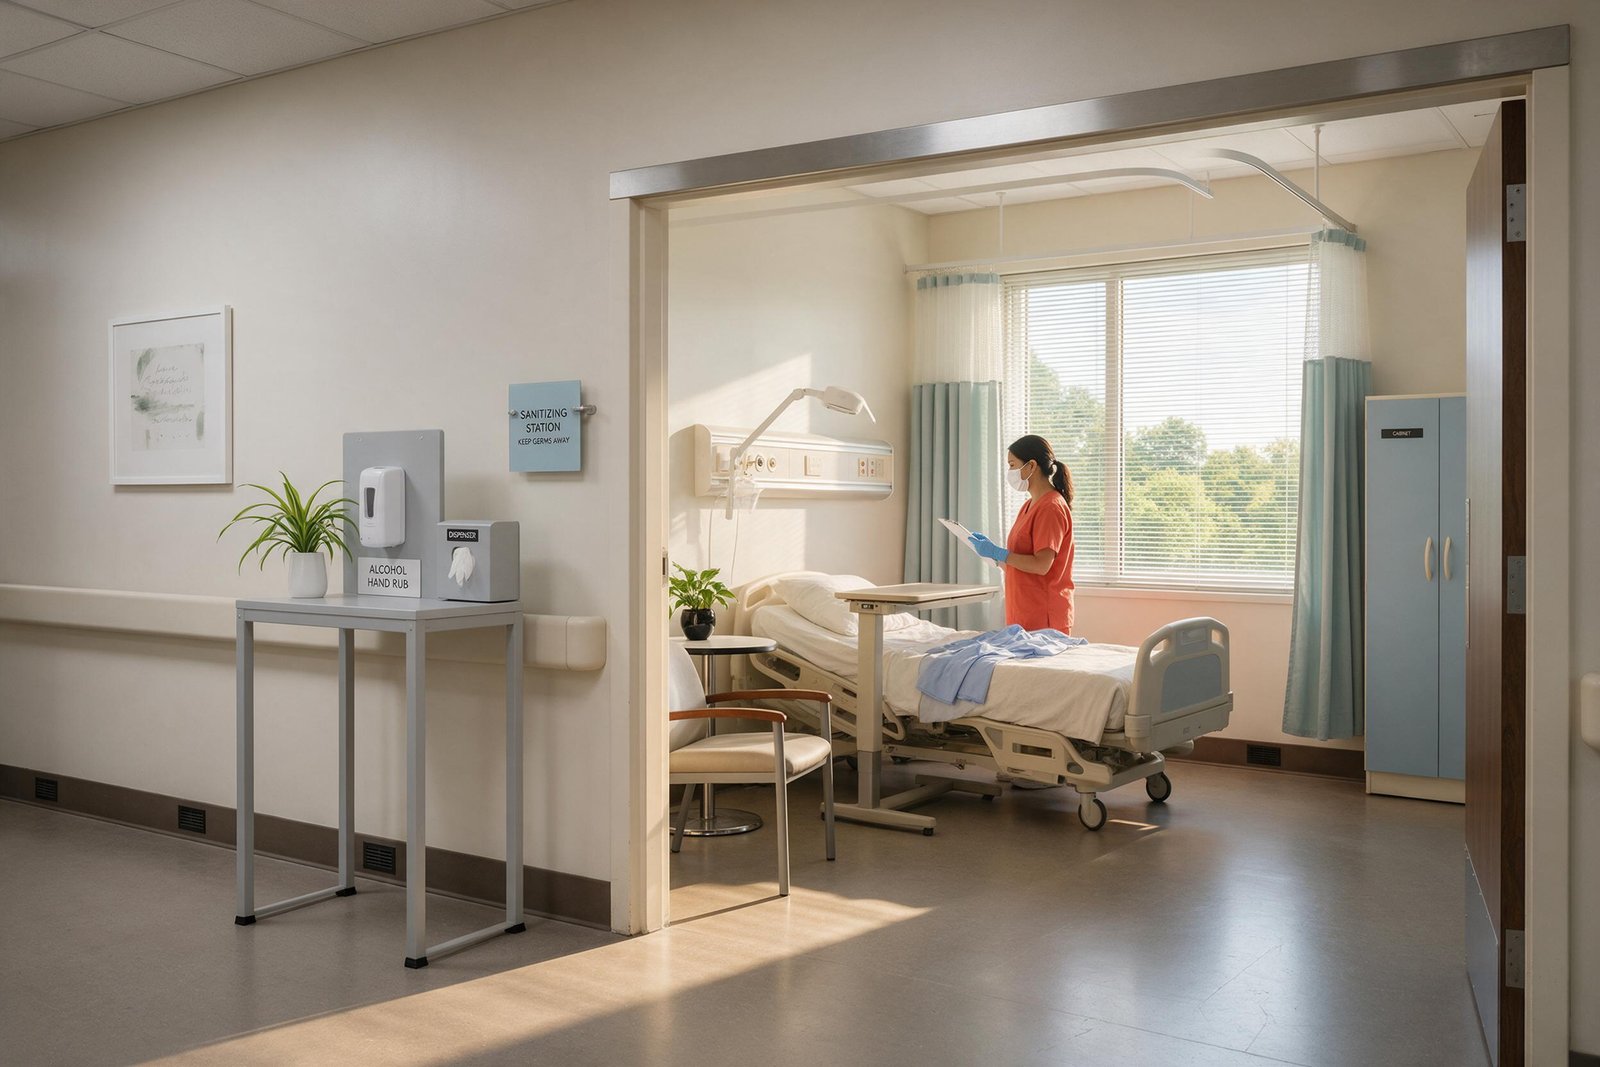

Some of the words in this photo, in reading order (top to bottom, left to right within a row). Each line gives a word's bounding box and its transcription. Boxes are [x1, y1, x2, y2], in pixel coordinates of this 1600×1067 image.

[520, 408, 568, 420] SANITIZING
[526, 422, 561, 433] STATION
[532, 437, 552, 445] GERMS
[369, 564, 408, 576] ALCOHOL
[367, 577, 391, 588] HAND
[392, 578, 409, 589] RUB
